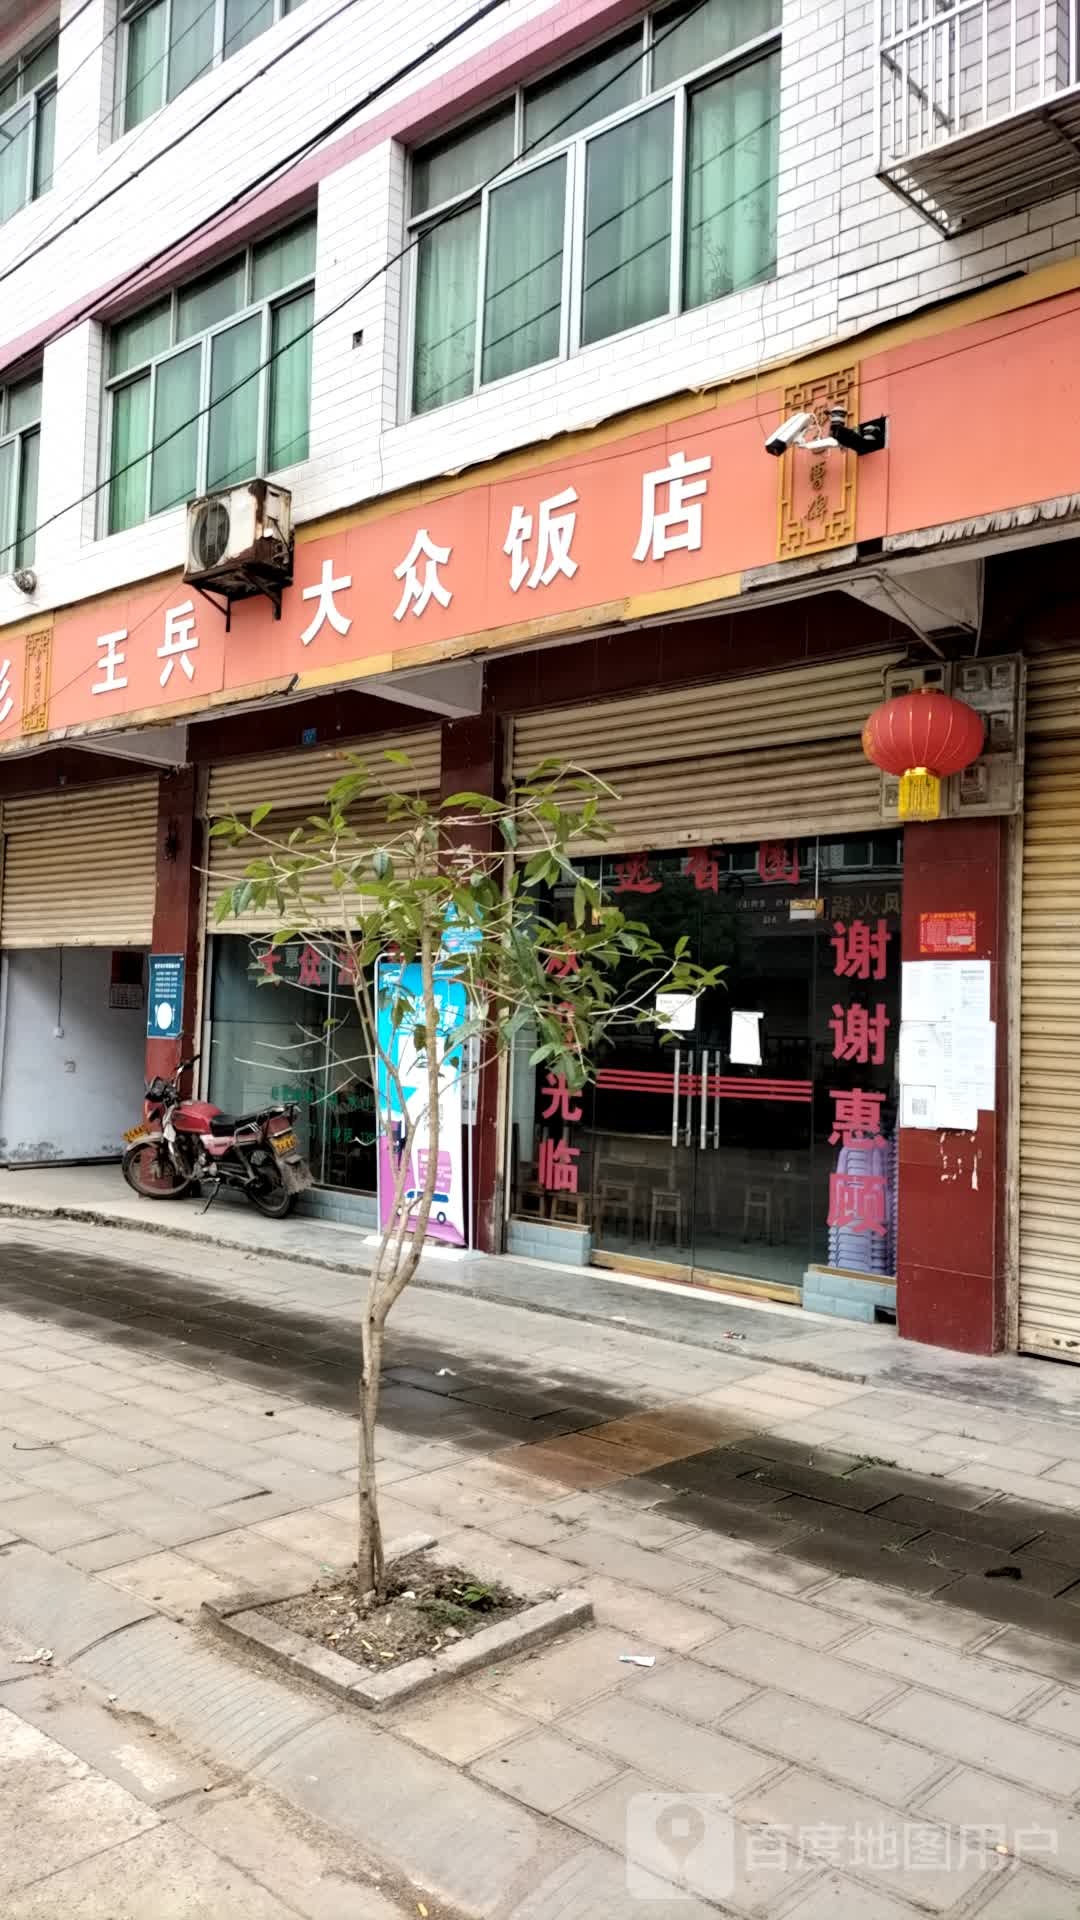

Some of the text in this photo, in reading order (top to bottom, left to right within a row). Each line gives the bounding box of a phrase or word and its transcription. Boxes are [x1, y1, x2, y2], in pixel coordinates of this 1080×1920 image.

[91, 451, 712, 696] 王兵大众饭店
[827, 918, 892, 1237] 谢谢惠顾
